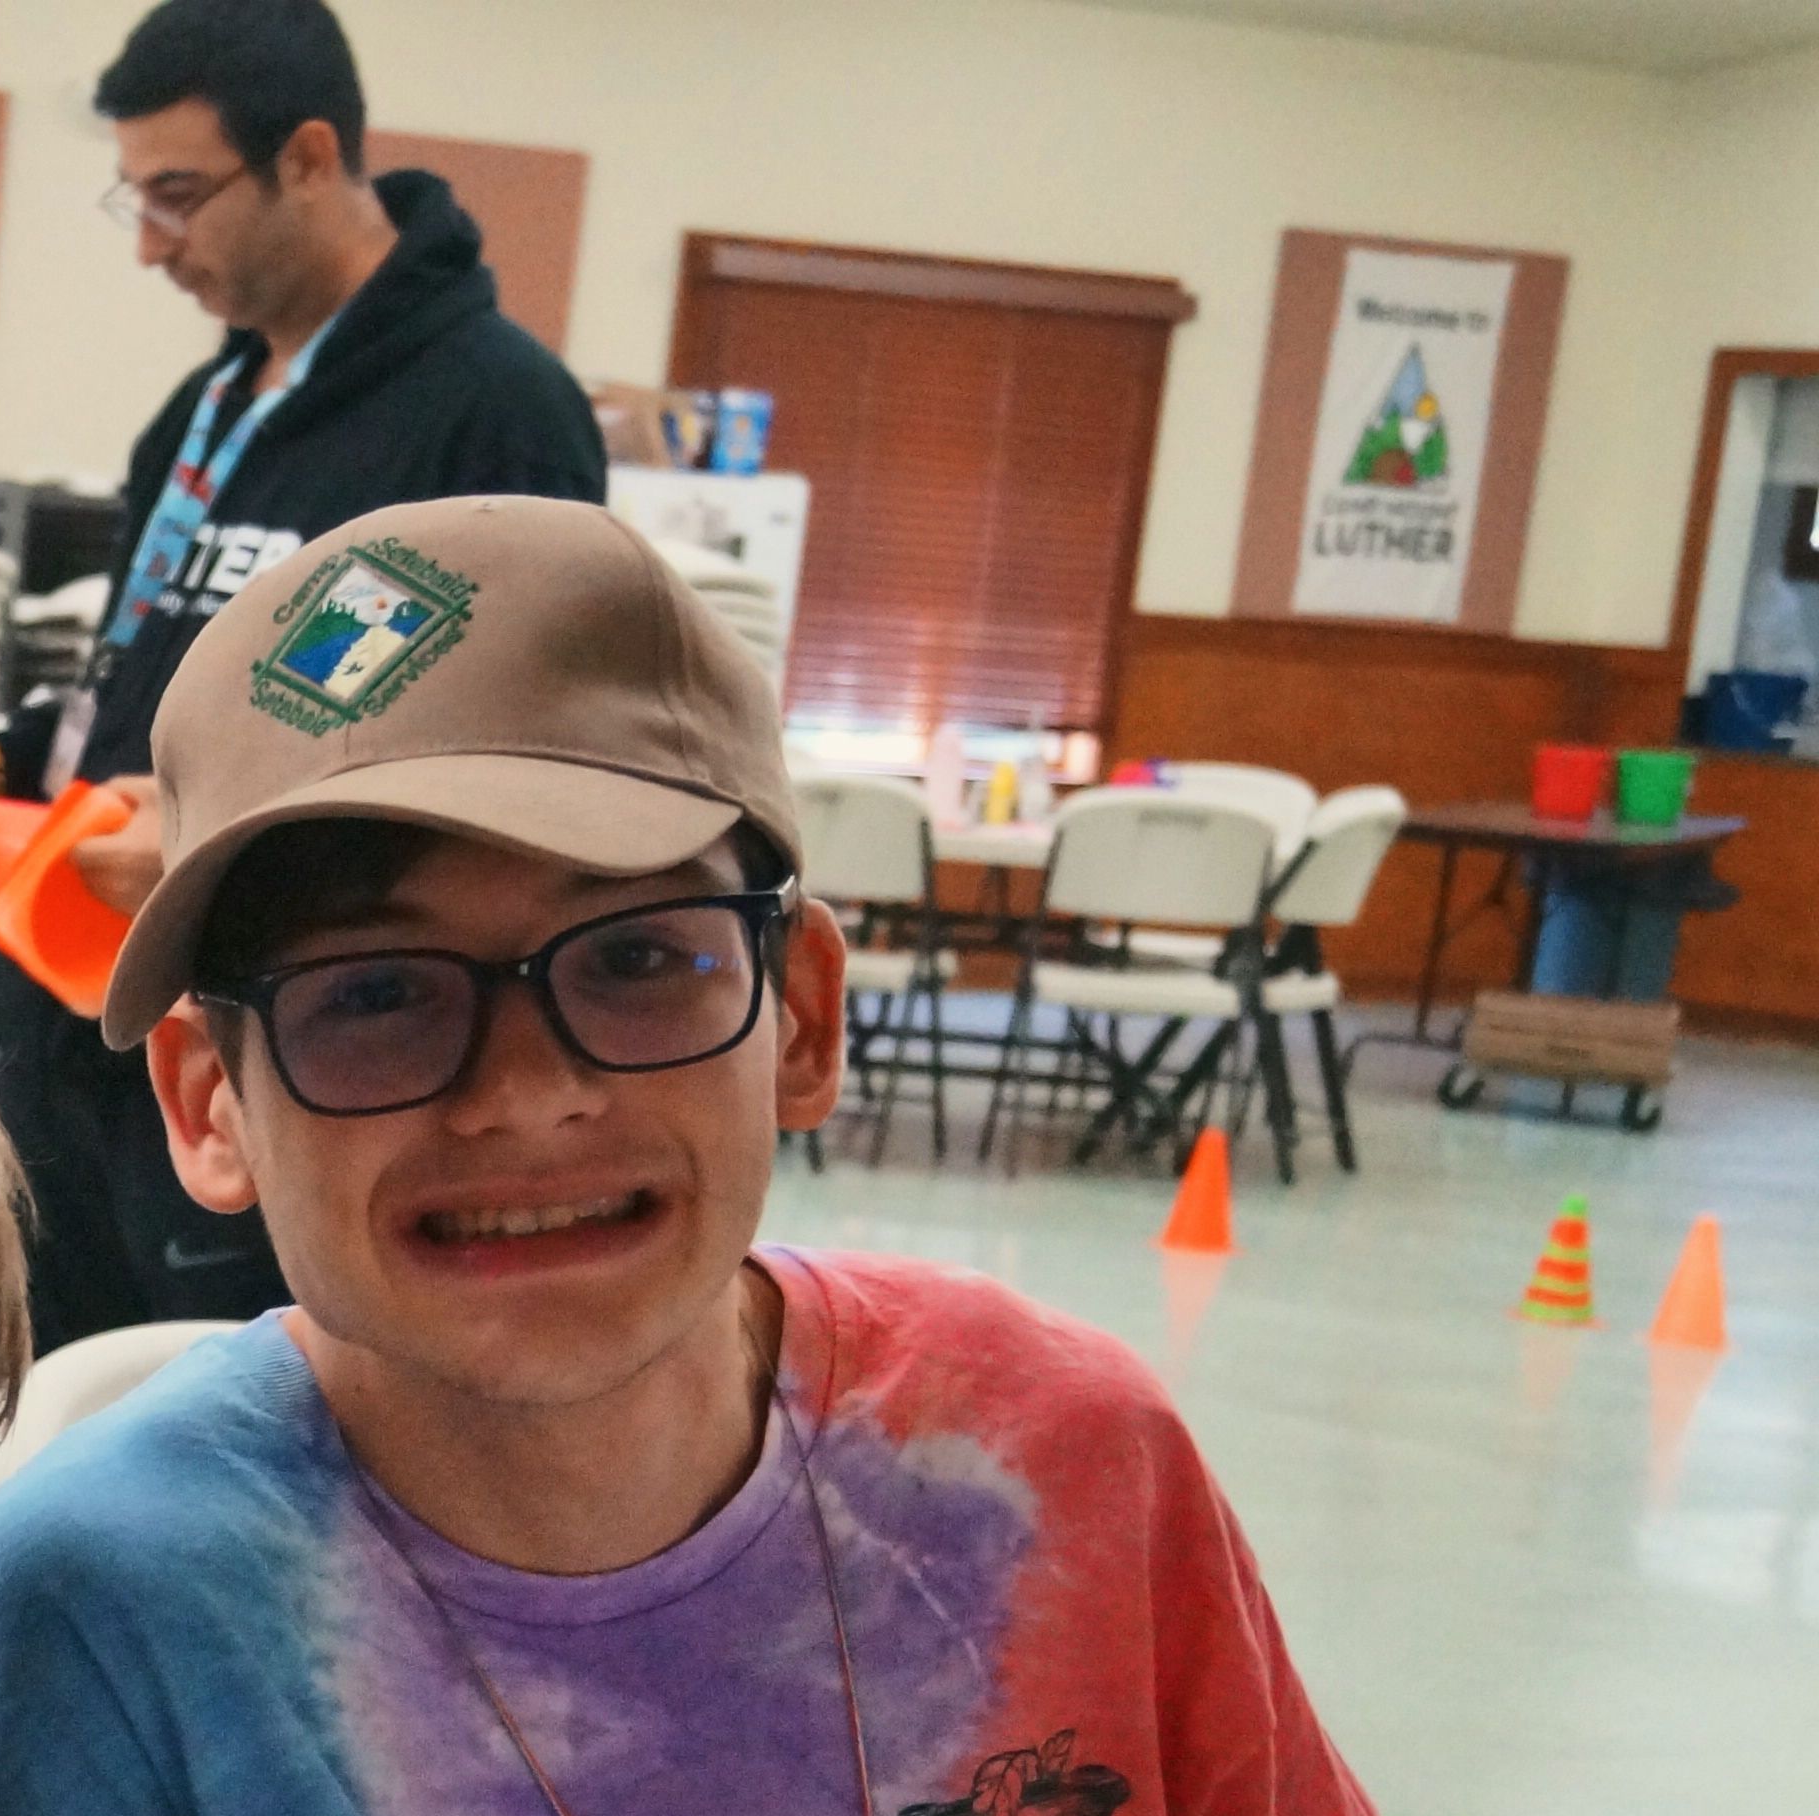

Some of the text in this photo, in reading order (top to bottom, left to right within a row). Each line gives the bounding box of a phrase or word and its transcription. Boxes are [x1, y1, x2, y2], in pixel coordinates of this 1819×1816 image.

[1356, 298, 1460, 330] Welcome
[1313, 522, 1455, 563] LUTHER
[273, 554, 340, 624] Camp
